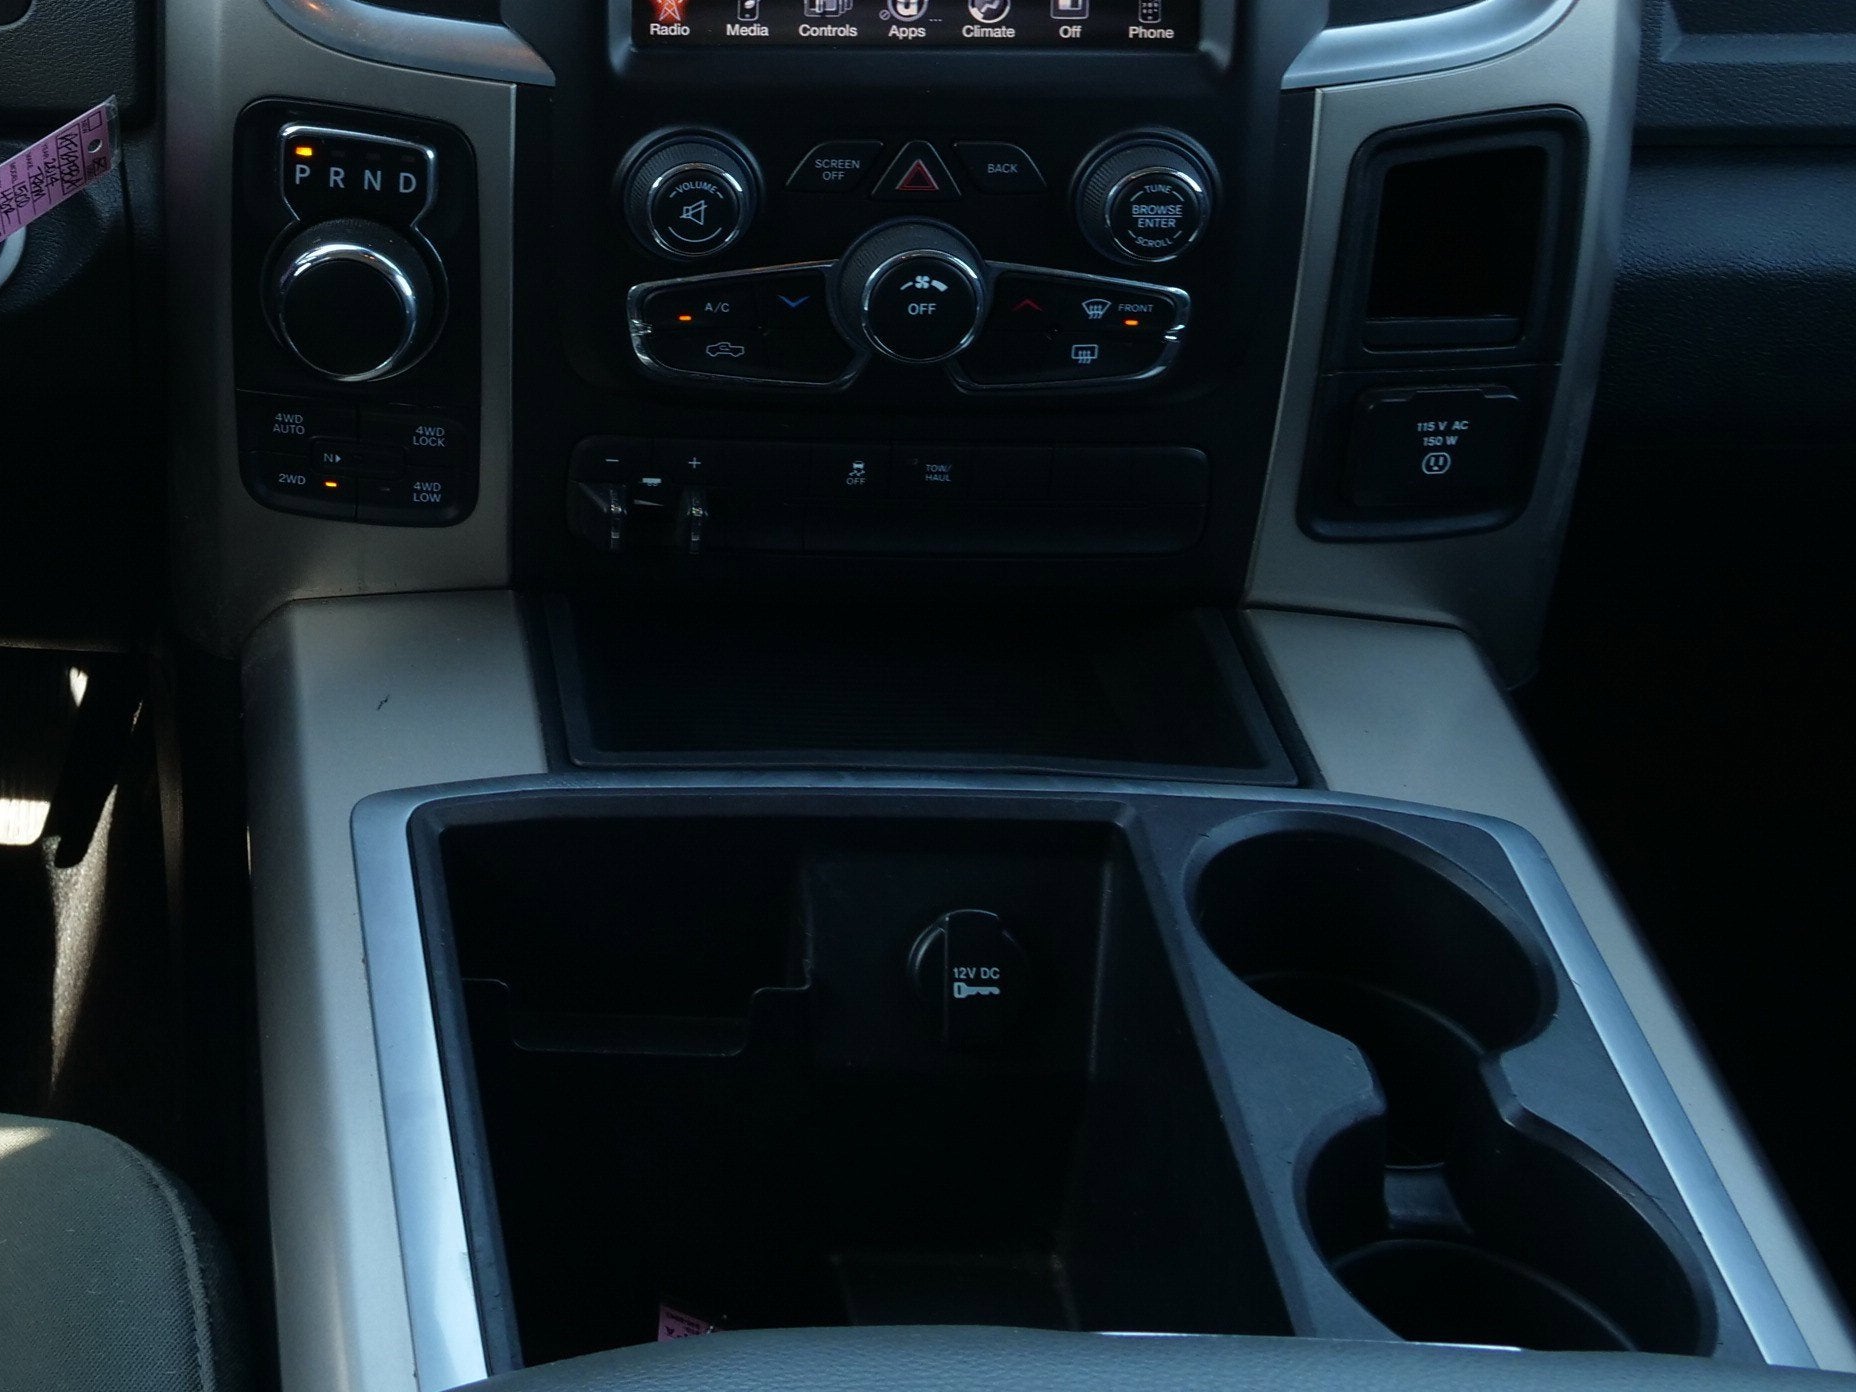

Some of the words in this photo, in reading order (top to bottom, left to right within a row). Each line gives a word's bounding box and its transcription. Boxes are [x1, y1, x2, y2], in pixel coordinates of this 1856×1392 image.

[650, 24, 690, 36] Radio
[726, 24, 769, 36] Media
[798, 24, 858, 37] Controls
[888, 25, 926, 39] Apps
[962, 25, 1016, 38] Climate
[1059, 25, 1082, 38] Off
[1128, 26, 1175, 39] Phone
[815, 159, 860, 169] SCREEN
[987, 164, 1019, 173] BACK
[295, 164, 311, 184] P
[329, 167, 345, 188] R
[364, 170, 382, 191] N
[399, 173, 417, 193] D
[822, 172, 845, 181] OFF
[28, 166, 47, 203] RAM
[675, 181, 718, 194] VOLUME
[1144, 184, 1173, 194] TUNE
[12, 180, 32, 208] 1500
[1132, 205, 1183, 214] BROWSE
[1137, 219, 1176, 228] ENTER
[1135, 236, 1173, 247] SCROLL
[704, 302, 731, 314] A/C
[907, 304, 937, 316] OFF
[1118, 304, 1154, 313] FRONT
[275, 413, 304, 424] 4WD
[273, 424, 306, 435] AUTO
[415, 426, 445, 437] 4WD
[1417, 422, 1436, 432] 115
[1438, 421, 1448, 431] V
[1452, 420, 1469, 430] AC
[413, 436, 446, 447] LOCK
[1423, 436, 1443, 447] 150
[1445, 436, 1458, 446] W
[323, 453, 333, 463] N
[278, 474, 306, 485] 2WD
[413, 481, 441, 492] 4WD
[413, 493, 441, 502] LOW
[953, 967, 976, 979] 12V
[980, 967, 1000, 979] DC
